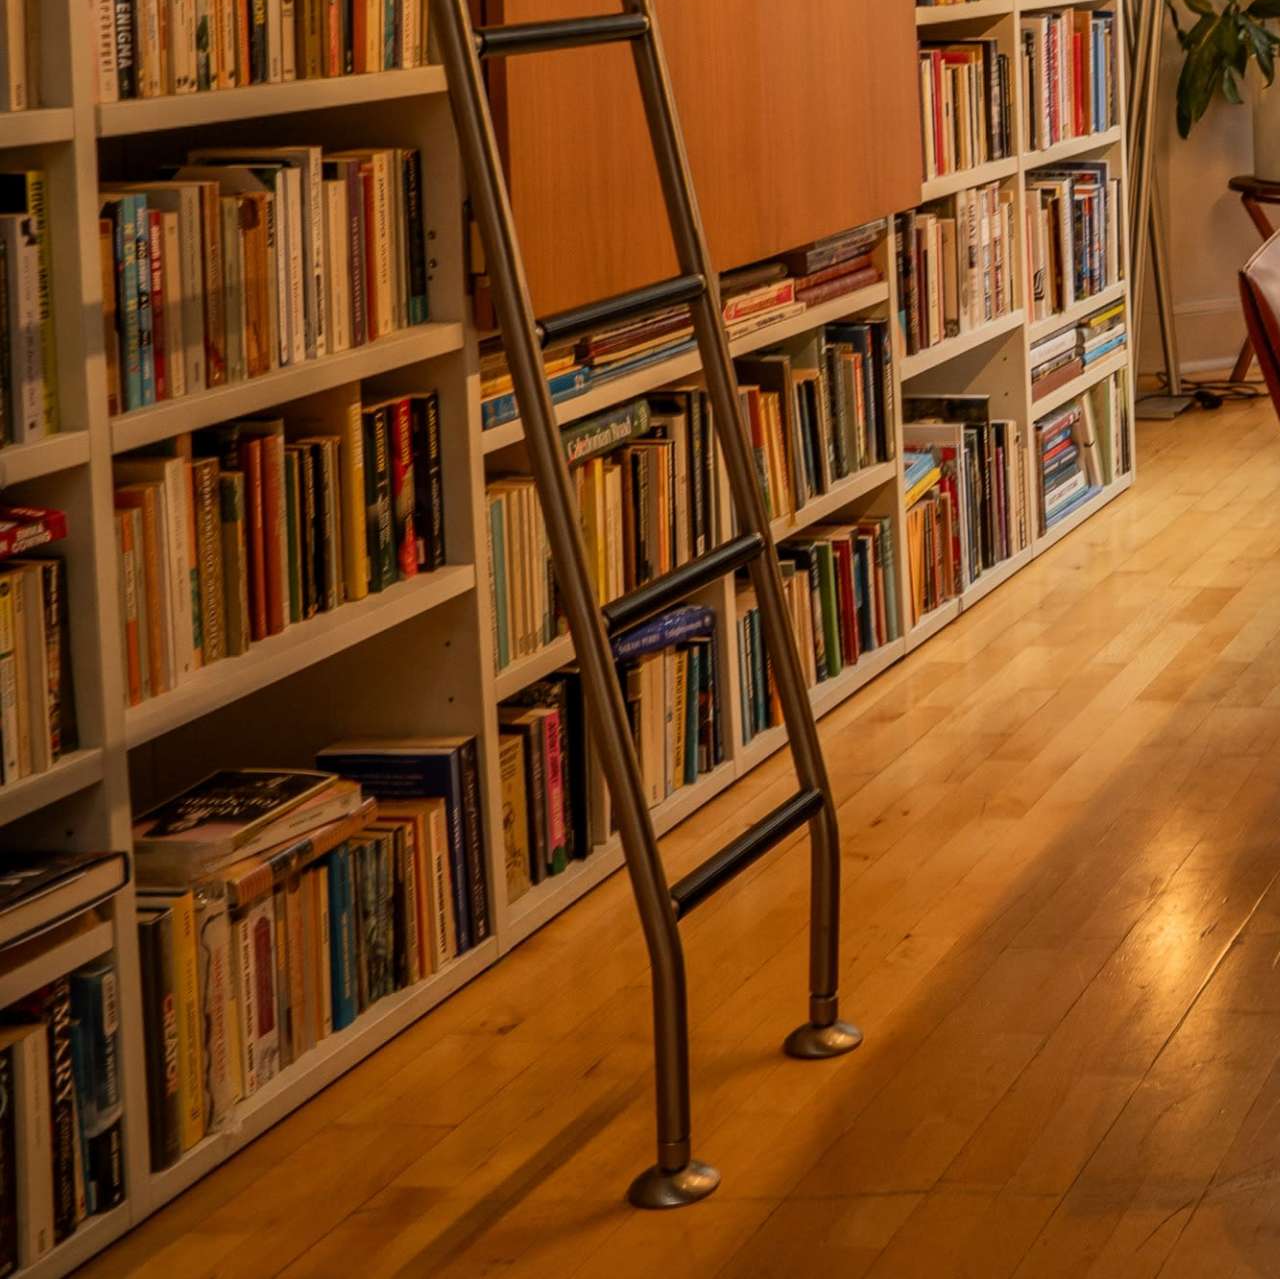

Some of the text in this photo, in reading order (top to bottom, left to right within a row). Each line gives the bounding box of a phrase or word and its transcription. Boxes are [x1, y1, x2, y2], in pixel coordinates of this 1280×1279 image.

[116, 2, 131, 70] ENIGMA
[124, 222, 136, 267] NICK
[967, 204, 977, 241] GRAY
[374, 411, 386, 473] LARSSON
[398, 406, 411, 465] LARSSON
[427, 401, 438, 459] LARSSON
[566, 413, 632, 462] Caledonian Road
[53, 1001, 74, 1106] MARY
[163, 993, 179, 1095] CREATOR
